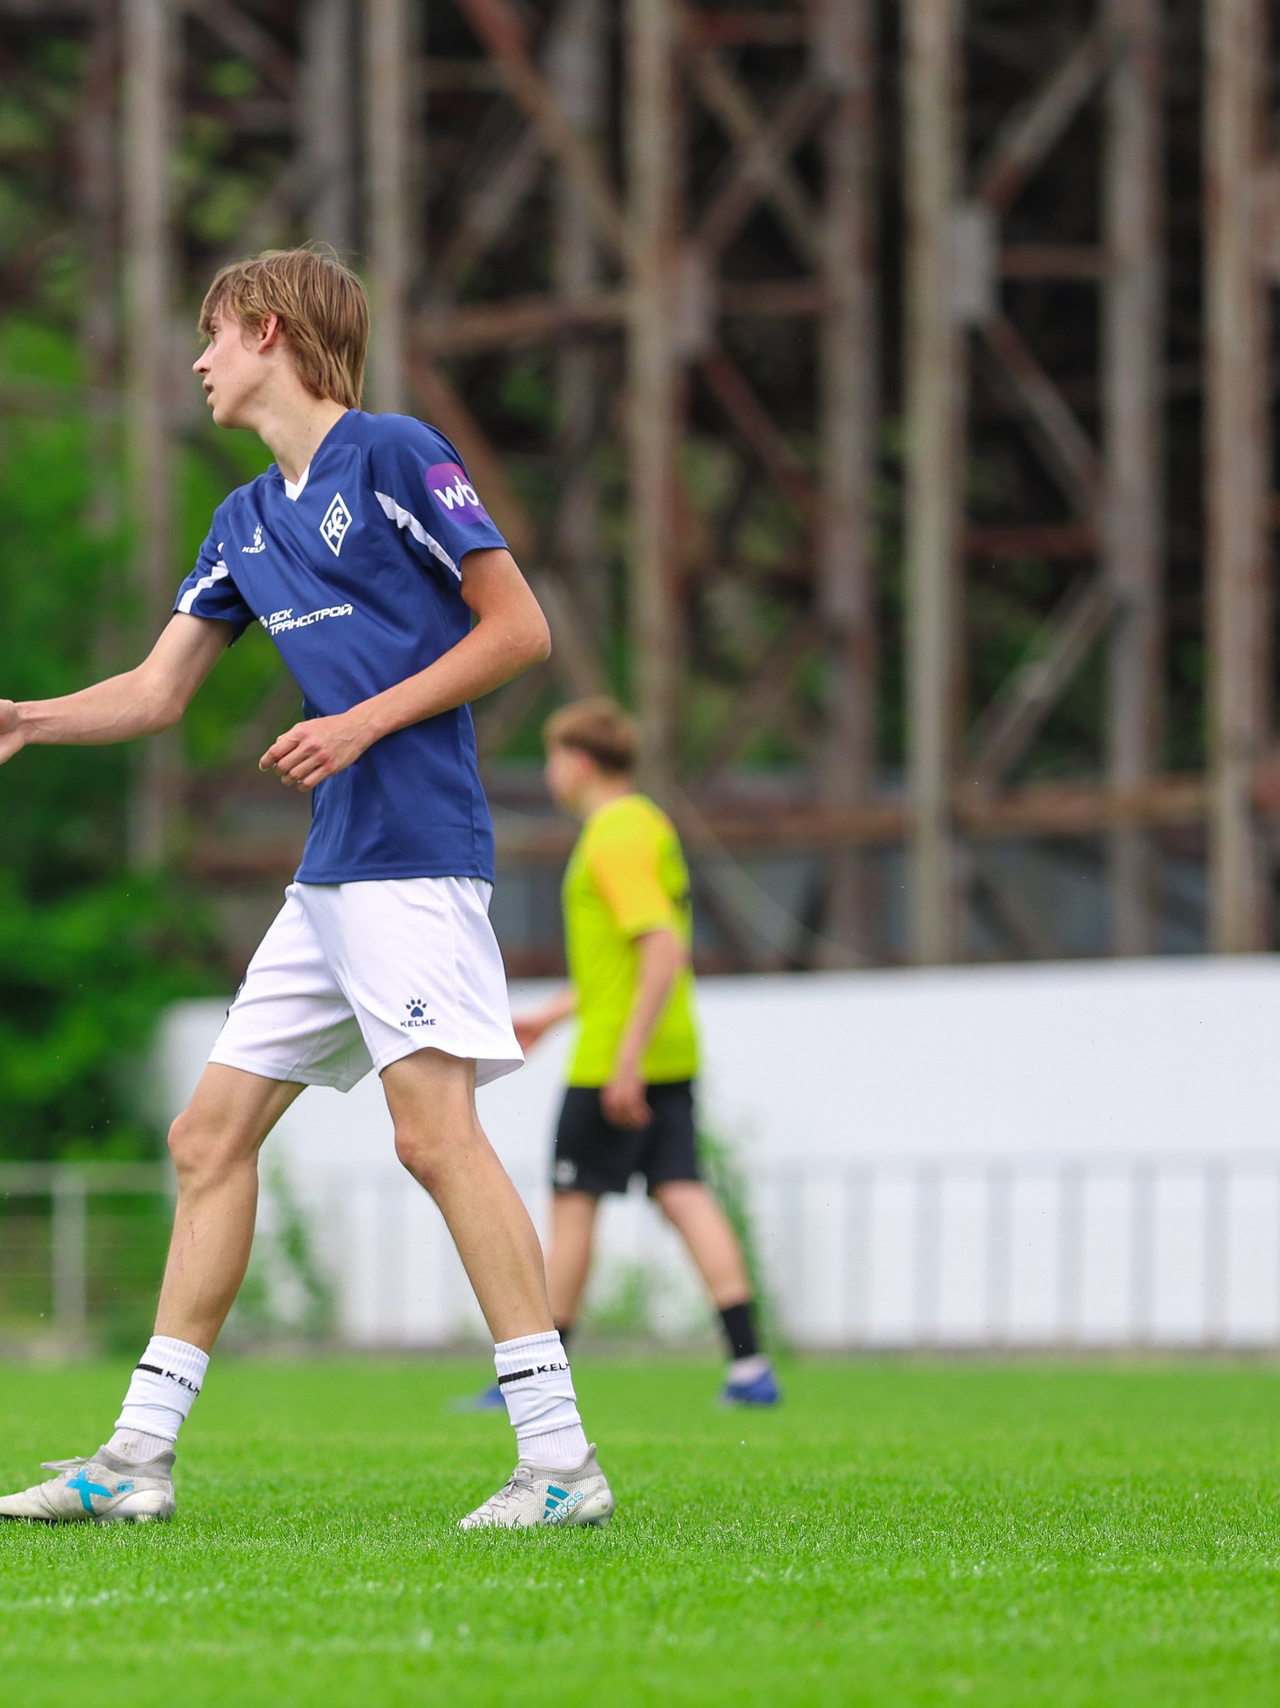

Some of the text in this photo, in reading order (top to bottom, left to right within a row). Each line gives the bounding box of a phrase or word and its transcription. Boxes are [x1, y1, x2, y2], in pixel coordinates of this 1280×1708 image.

[433, 475, 480, 510] wb
[269, 603, 353, 636] ТРАНССТРОЙ
[400, 1018, 436, 1027] KELME
[537, 1362, 570, 1374] KEL
[165, 1370, 200, 1397] KELM
[545, 1491, 584, 1526] didas
